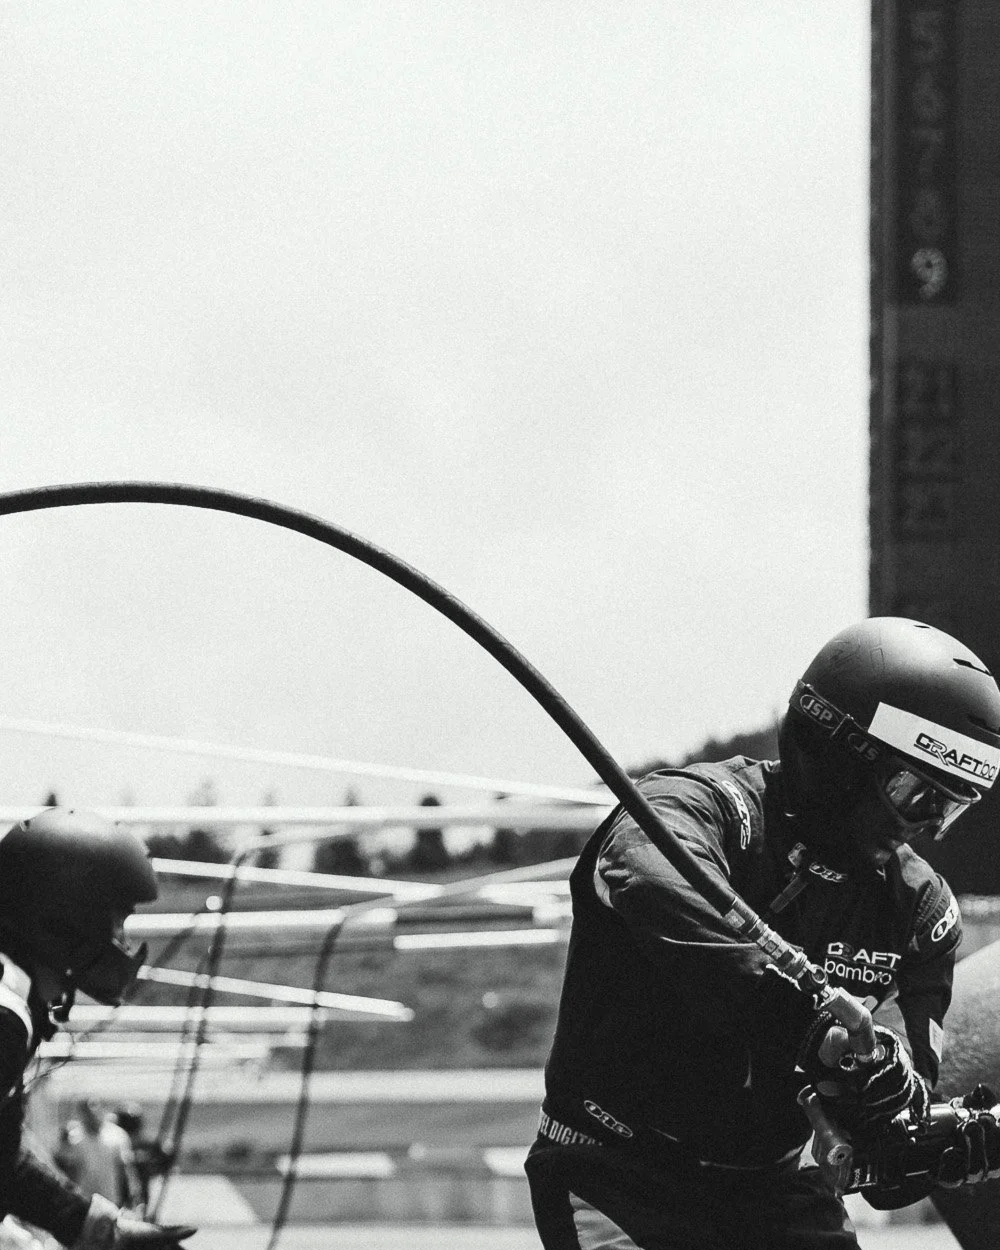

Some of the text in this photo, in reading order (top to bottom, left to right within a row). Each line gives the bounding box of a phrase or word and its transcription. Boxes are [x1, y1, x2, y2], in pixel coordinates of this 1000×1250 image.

[911, 247, 948, 298] 9
[803, 699, 834, 722] JSP
[823, 958, 892, 986] bamboo
